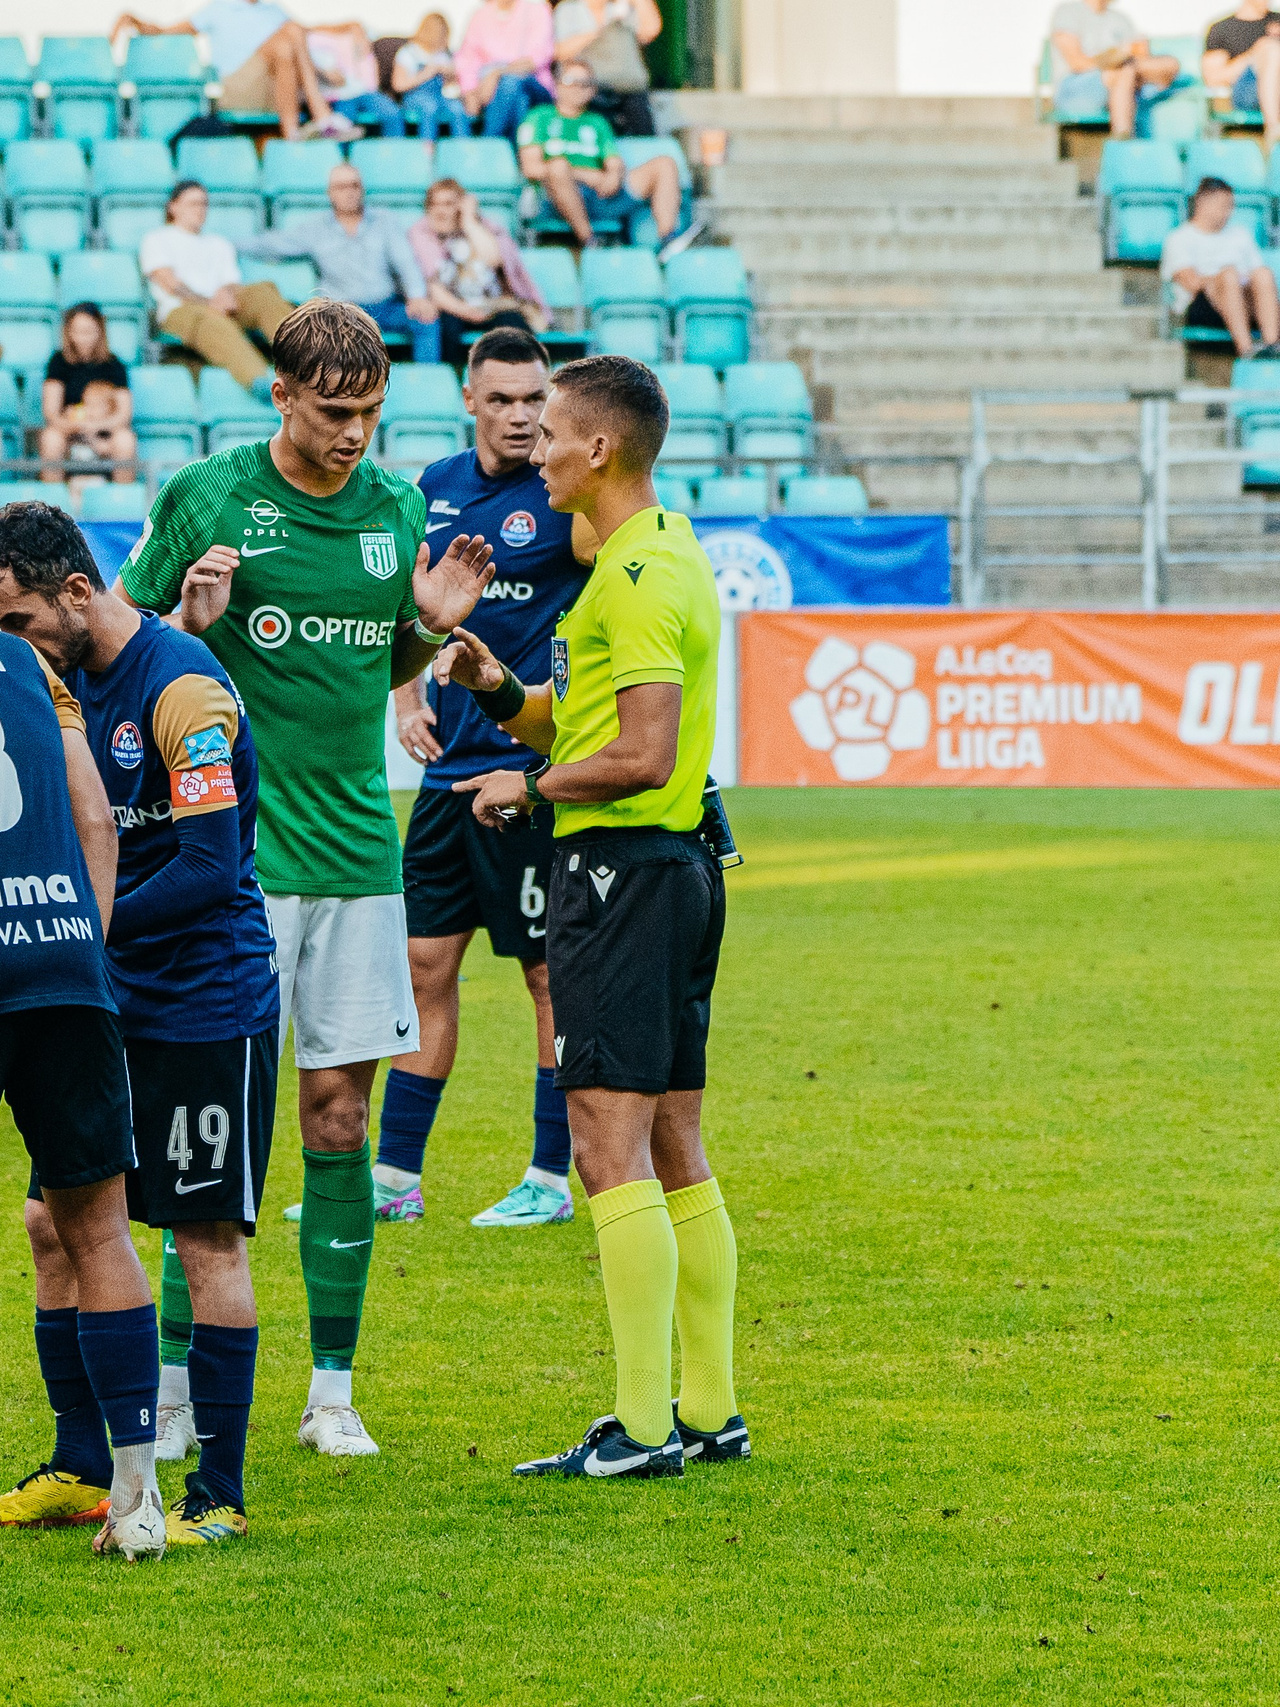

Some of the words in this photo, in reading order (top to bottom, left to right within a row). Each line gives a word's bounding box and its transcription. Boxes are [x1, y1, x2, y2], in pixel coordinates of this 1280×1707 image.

[243, 528, 289, 538] OPEL
[299, 616, 396, 647] OPTIBET
[934, 643, 1053, 682] A.LeCoq
[935, 682, 1142, 725] PREMIUM
[1178, 661, 1280, 746] OL
[935, 726, 1045, 769] LIIGA
[186, 781, 200, 791] PL
[520, 867, 545, 918] 6
[36, 917, 93, 943] LINN
[166, 1104, 230, 1171] 49
[139, 1408, 150, 1426] 8
